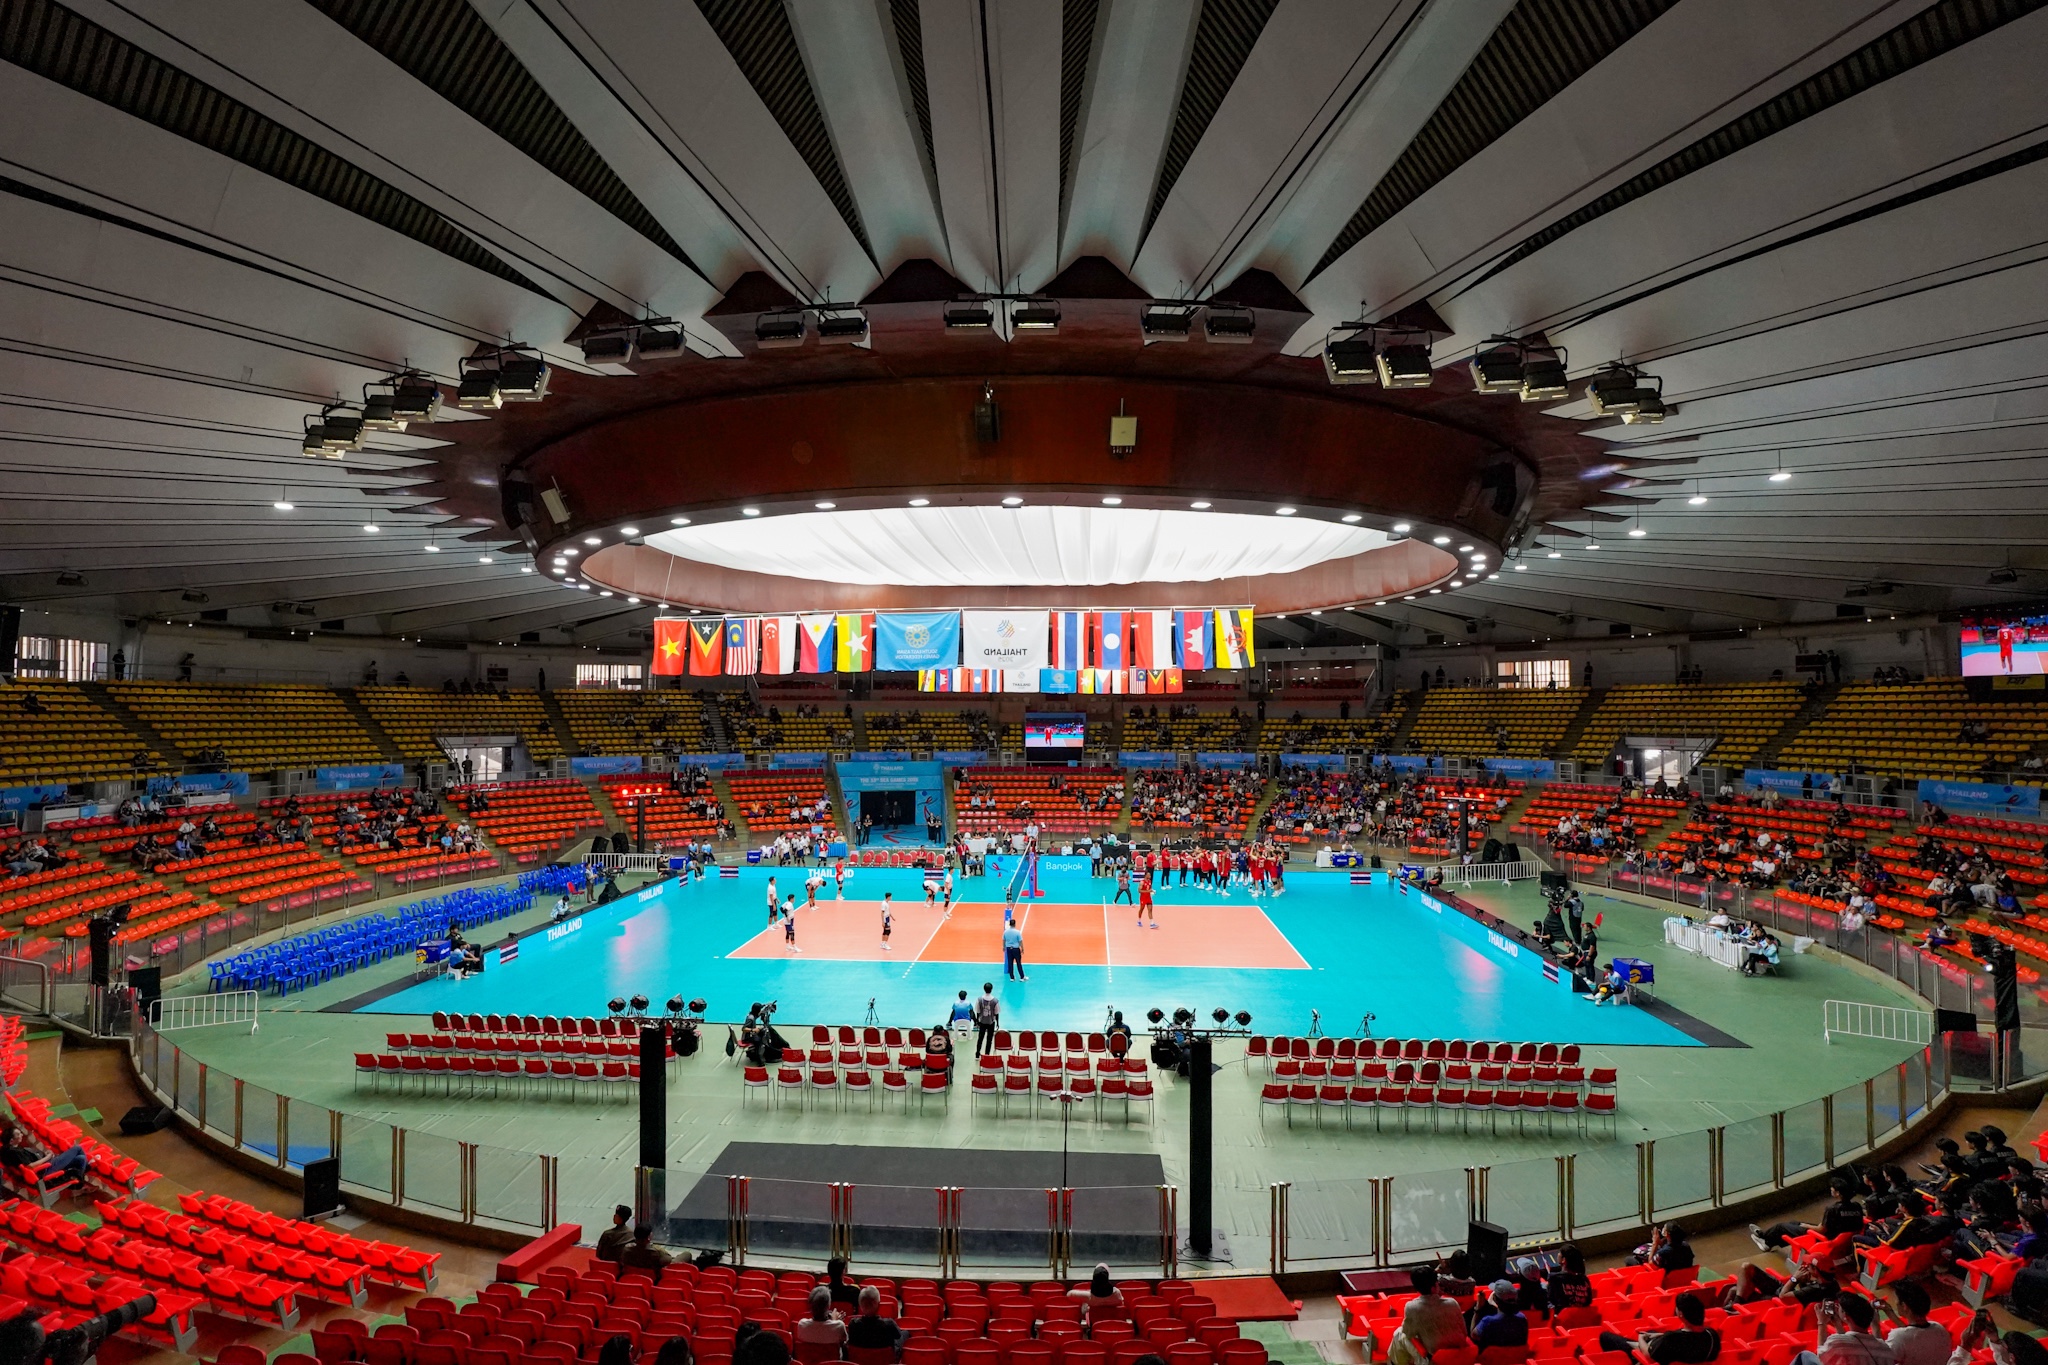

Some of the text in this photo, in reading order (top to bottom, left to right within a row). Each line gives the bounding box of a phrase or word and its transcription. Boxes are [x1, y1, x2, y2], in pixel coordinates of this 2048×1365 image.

[1761, 777, 1803, 787] VOLLEYBAL
[1947, 789, 1989, 799] THAILAND
[808, 868, 854, 878] THAILND
[1046, 861, 1083, 872] Bangkok
[637, 885, 664, 903] THAILAND
[1420, 893, 1442, 914] THAILAND
[547, 917, 583, 942] THAILAND
[1487, 930, 1518, 958] THAILAND
